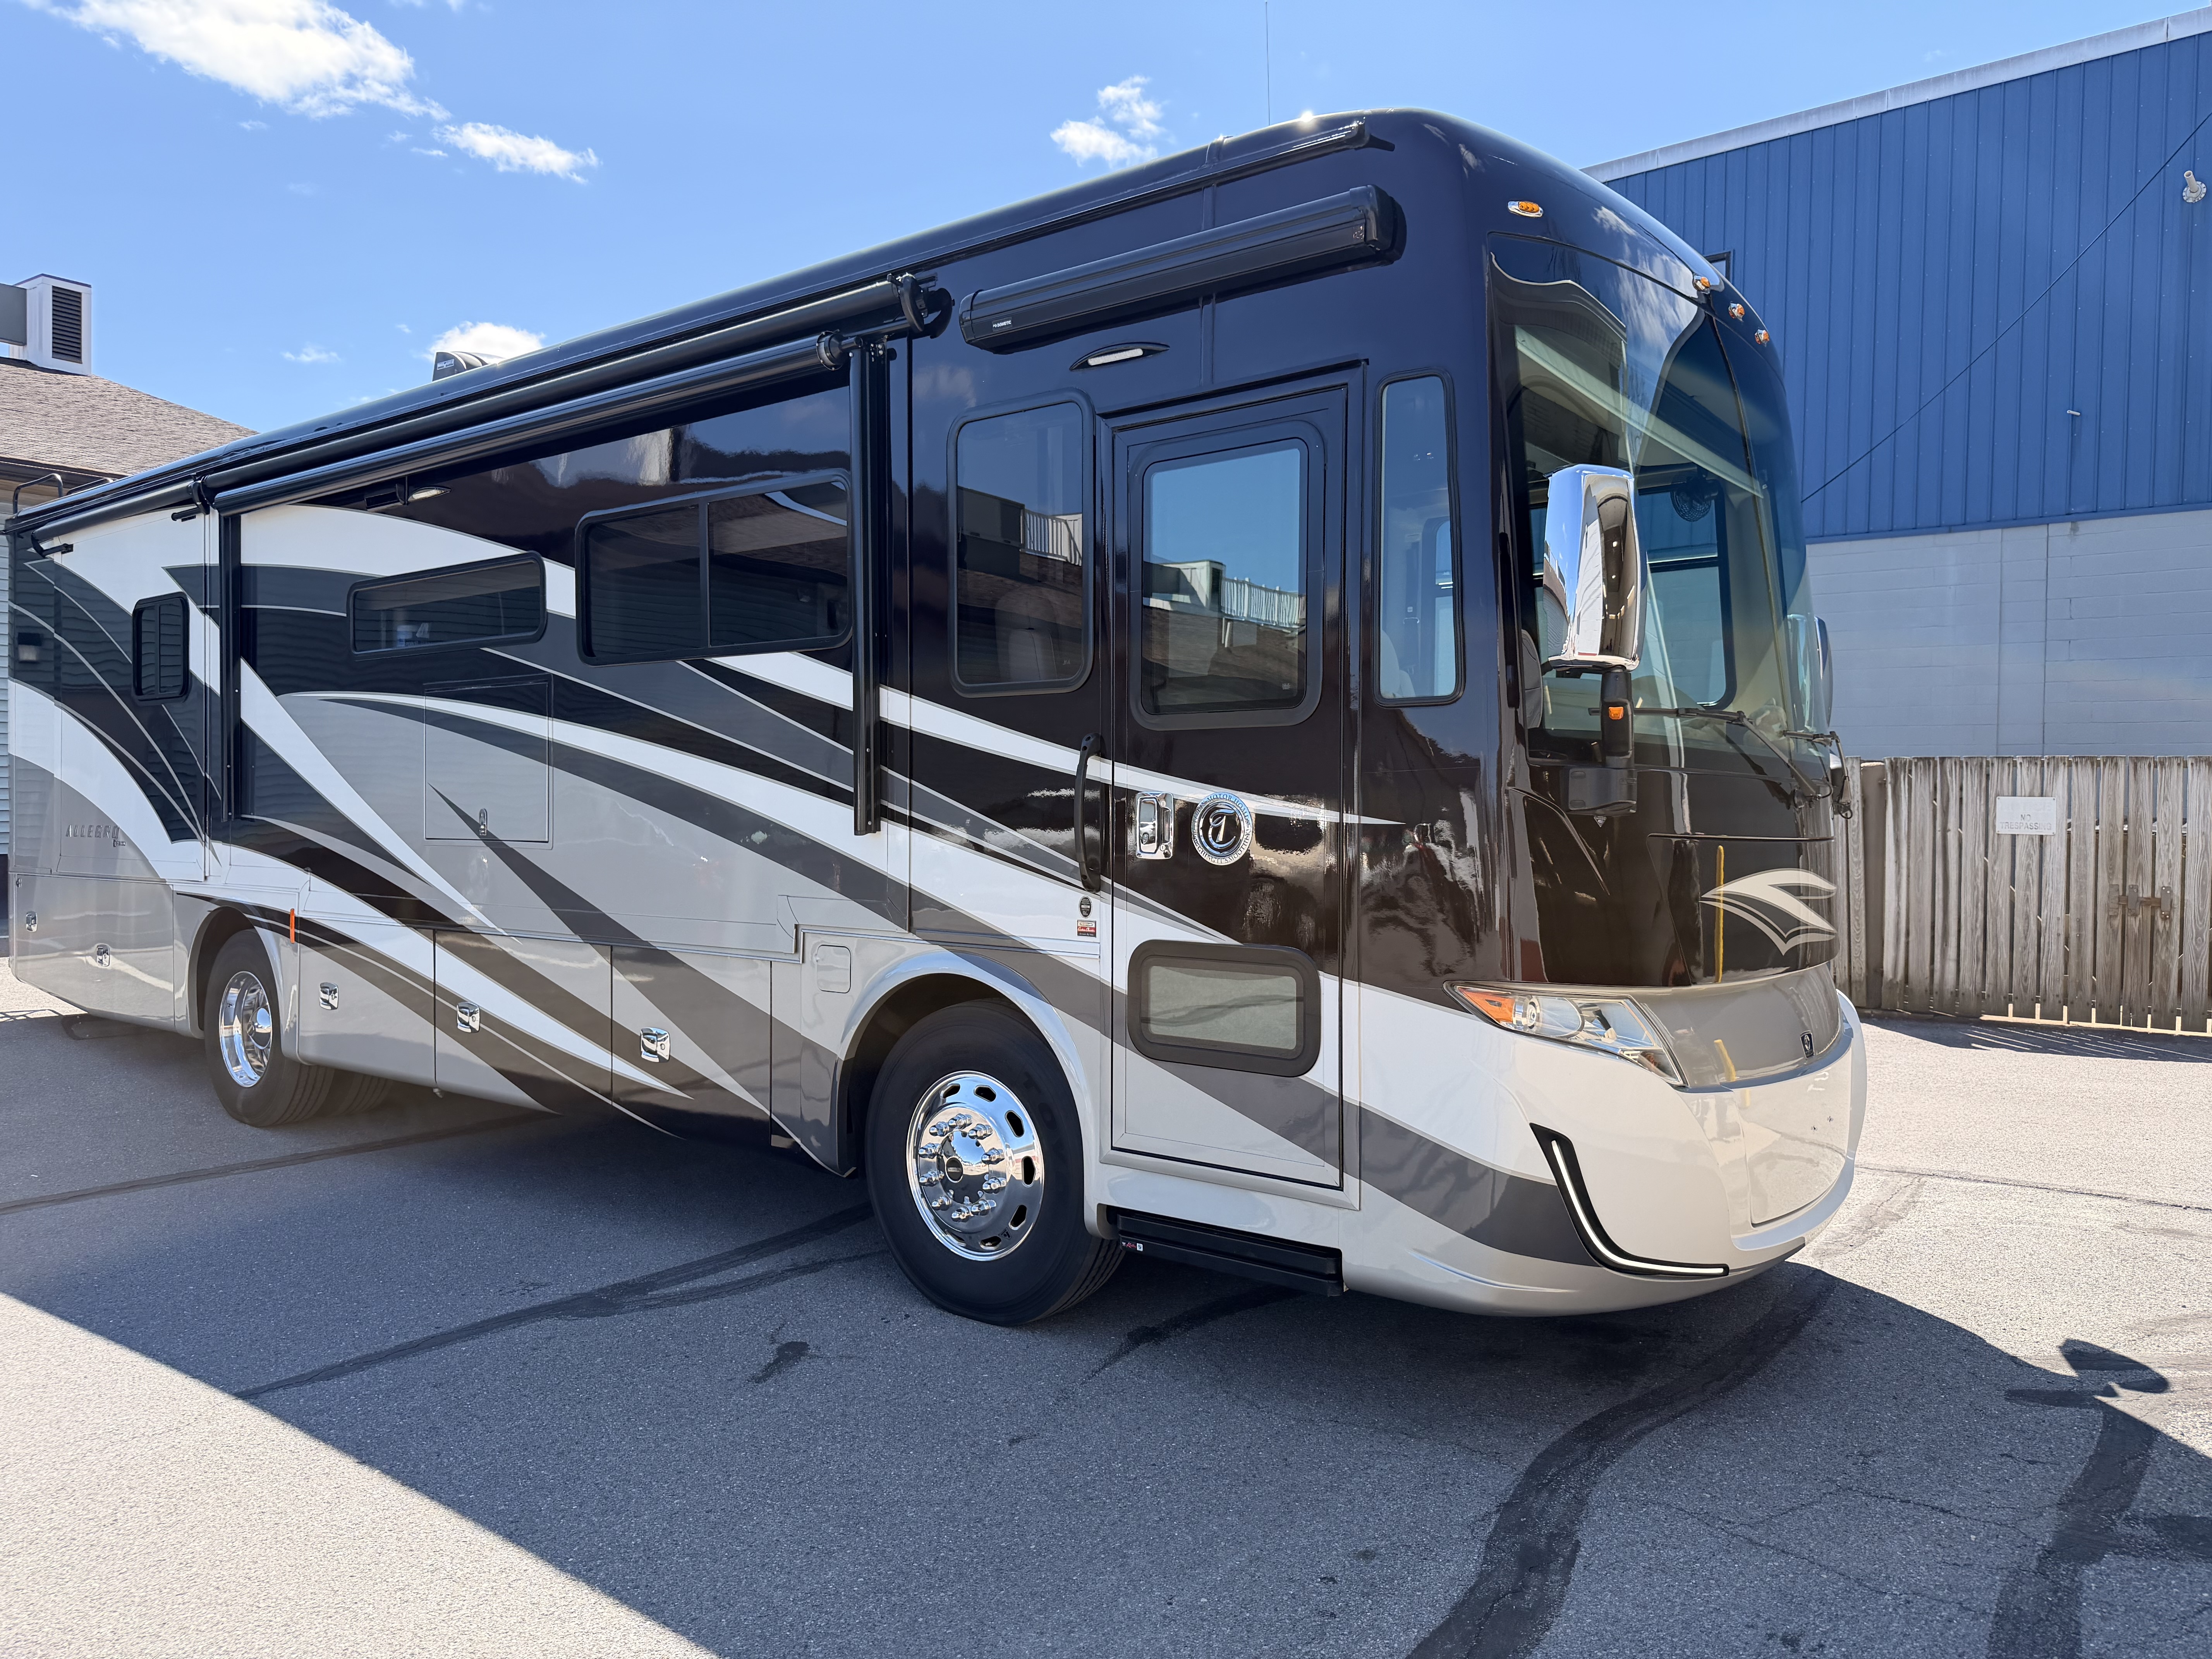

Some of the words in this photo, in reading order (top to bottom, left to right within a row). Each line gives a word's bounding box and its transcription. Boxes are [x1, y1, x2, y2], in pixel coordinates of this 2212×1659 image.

[1207, 793, 1232, 802] MOTOR
[2000, 822, 2052, 830] TRESPASSING
[65, 824, 120, 839] ALLEGRO
